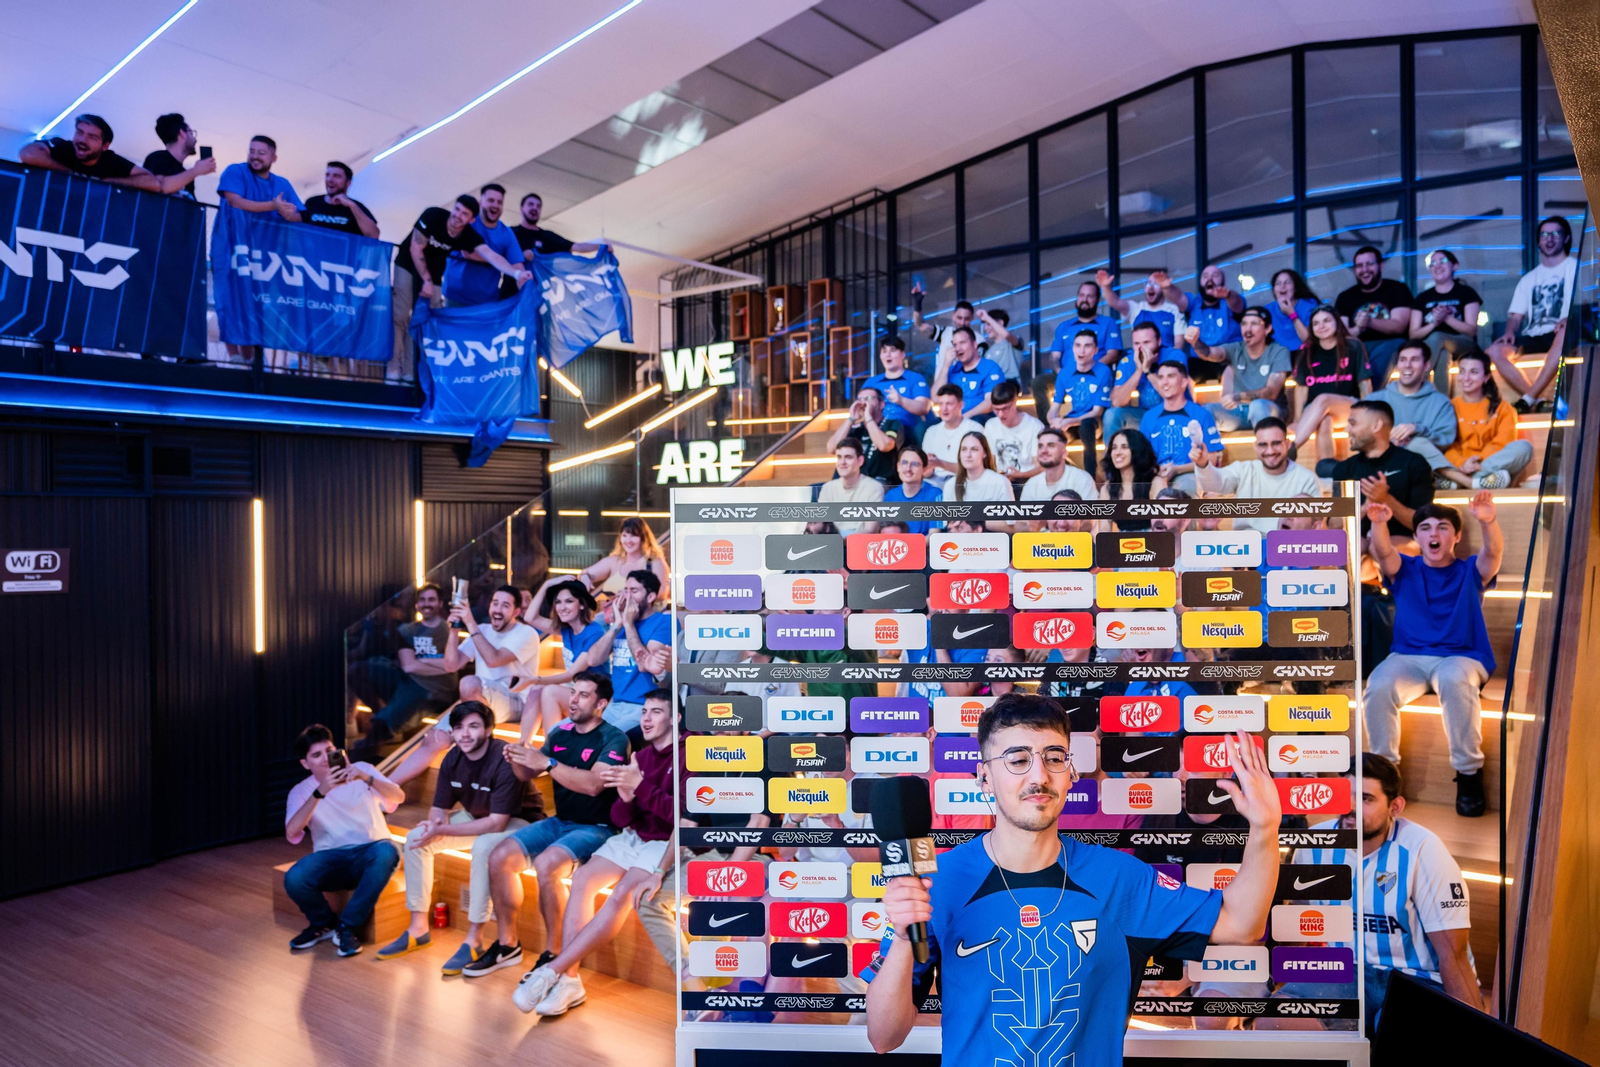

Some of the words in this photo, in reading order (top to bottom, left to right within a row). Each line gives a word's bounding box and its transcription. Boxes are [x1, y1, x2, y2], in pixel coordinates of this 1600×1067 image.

[0, 226, 140, 290] NTS
[231, 245, 381, 298] GIANTS
[276, 295, 305, 308] ARE
[306, 300, 356, 316] GIANTS
[661, 341, 736, 392] WE
[453, 376, 475, 384] ARE
[656, 438, 745, 484] ARE
[699, 507, 758, 518] GIANTS
[768, 506, 829, 518] GIANTS
[840, 506, 900, 518] GIANTS
[910, 506, 970, 518] GIANTS
[983, 504, 1044, 516] GIANTS
[1055, 504, 1116, 516] GIANTS
[1127, 504, 1188, 516] GIANTS
[1199, 503, 1261, 514] GIANTS
[1272, 502, 1333, 514] GIANTS
[872, 541, 908, 563] KitKat
[1033, 545, 1075, 560] Nesquik
[1196, 545, 1249, 555] DIGI
[1278, 544, 1338, 553] FITCHIN
[11, 556, 30, 568] Wi
[40, 554, 52, 568] Fi
[695, 589, 752, 597] FITCHIN
[955, 581, 992, 603] KitKat
[1116, 585, 1159, 599] Nesquik
[1282, 584, 1335, 595] DIGI
[699, 628, 750, 638] DIGI
[777, 629, 835, 637] FITCHIN
[1037, 620, 1075, 642] KitKat
[1202, 624, 1245, 639] Nesquik
[701, 668, 760, 679] GIANTS
[770, 667, 831, 679] GIANTS
[842, 667, 902, 679] GIANTS
[912, 667, 973, 679] GIANTS
[984, 666, 1046, 679] GIANTS
[1056, 666, 1118, 678] GIANTS
[1129, 666, 1190, 678] GIANTS
[1201, 666, 1262, 678] GIANTS
[1273, 665, 1336, 677] GIANTS
[782, 710, 833, 720] DIGI
[861, 711, 919, 719] FITCHIN
[1121, 702, 1160, 726] KitKat
[1289, 708, 1332, 722] Nesquik
[705, 747, 746, 762] Nesquik
[865, 751, 917, 761] DIGI
[944, 751, 982, 760] FITC
[788, 790, 829, 805] Nesquik
[949, 791, 995, 802] DIG
[1292, 785, 1330, 808] KitKat
[703, 832, 762, 843] GIANTS
[772, 832, 833, 844] GIANTS
[843, 833, 882, 844] GIAN
[1130, 833, 1192, 845] GIANTS
[1202, 833, 1250, 845] GIAN
[1278, 833, 1338, 845] GIANTS
[709, 868, 747, 891] KitKat
[791, 909, 830, 932] KitKat
[1300, 923, 1324, 932] KING
[1203, 960, 1256, 970] DIGI
[1283, 961, 1344, 970] FITCHIN
[705, 996, 765, 1008] GIANTS
[775, 997, 835, 1008] GIANTS
[1133, 1001, 1193, 1012] GIANTS
[1204, 1001, 1267, 1014] GIANTS
[1277, 1002, 1340, 1014] GIANTS
